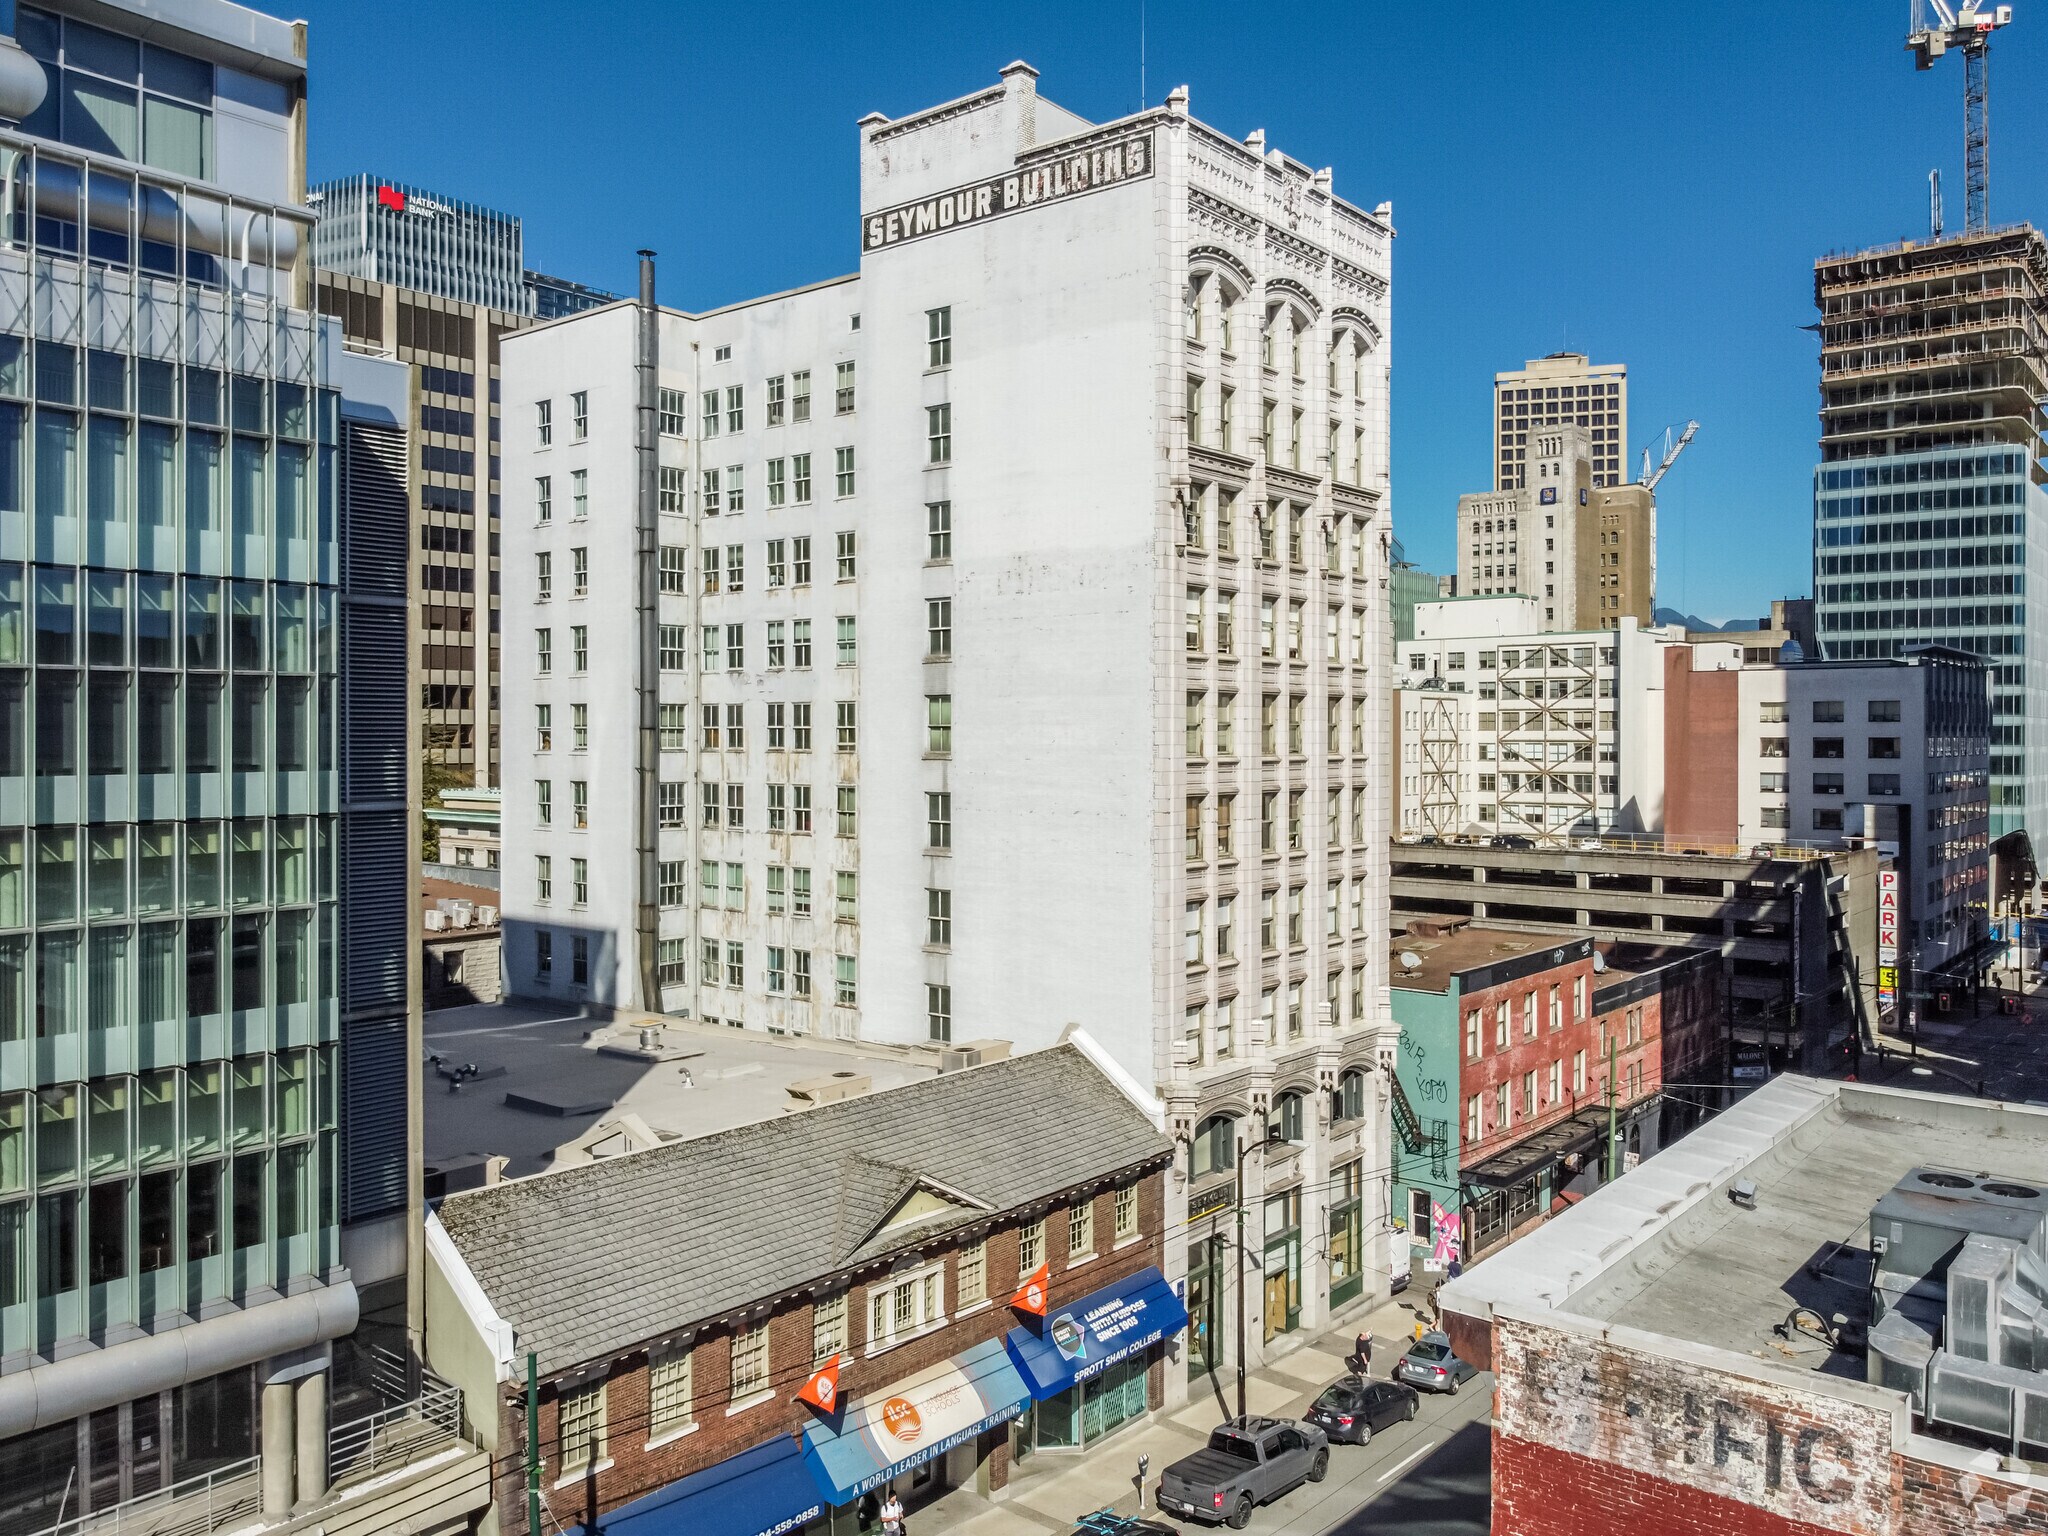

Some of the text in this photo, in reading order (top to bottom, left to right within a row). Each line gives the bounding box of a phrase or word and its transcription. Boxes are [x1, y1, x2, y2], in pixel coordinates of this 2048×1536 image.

[408, 195, 454, 215] NATIONAL
[869, 140, 1145, 247] SEYMOUR BUILDING
[408, 204, 435, 219] BANK
[1881, 873, 1896, 945] PARK
[1083, 1297, 1124, 1322] LEARNING
[1089, 1299, 1147, 1333] WITH PURPOSE
[1096, 1316, 1139, 1342] SINCE 1903
[1073, 1329, 1162, 1383] SPROTT SHAW COLLEGE
[921, 1384, 961, 1409] LANGUAGE
[925, 1394, 961, 1417] SCHOOLS
[886, 1402, 912, 1422] ilsc
[852, 1402, 1021, 1497] A WORLD LEADER IN LANGUAGE TRAINING
[755, 1505, 819, 1536] 4-558-0858
